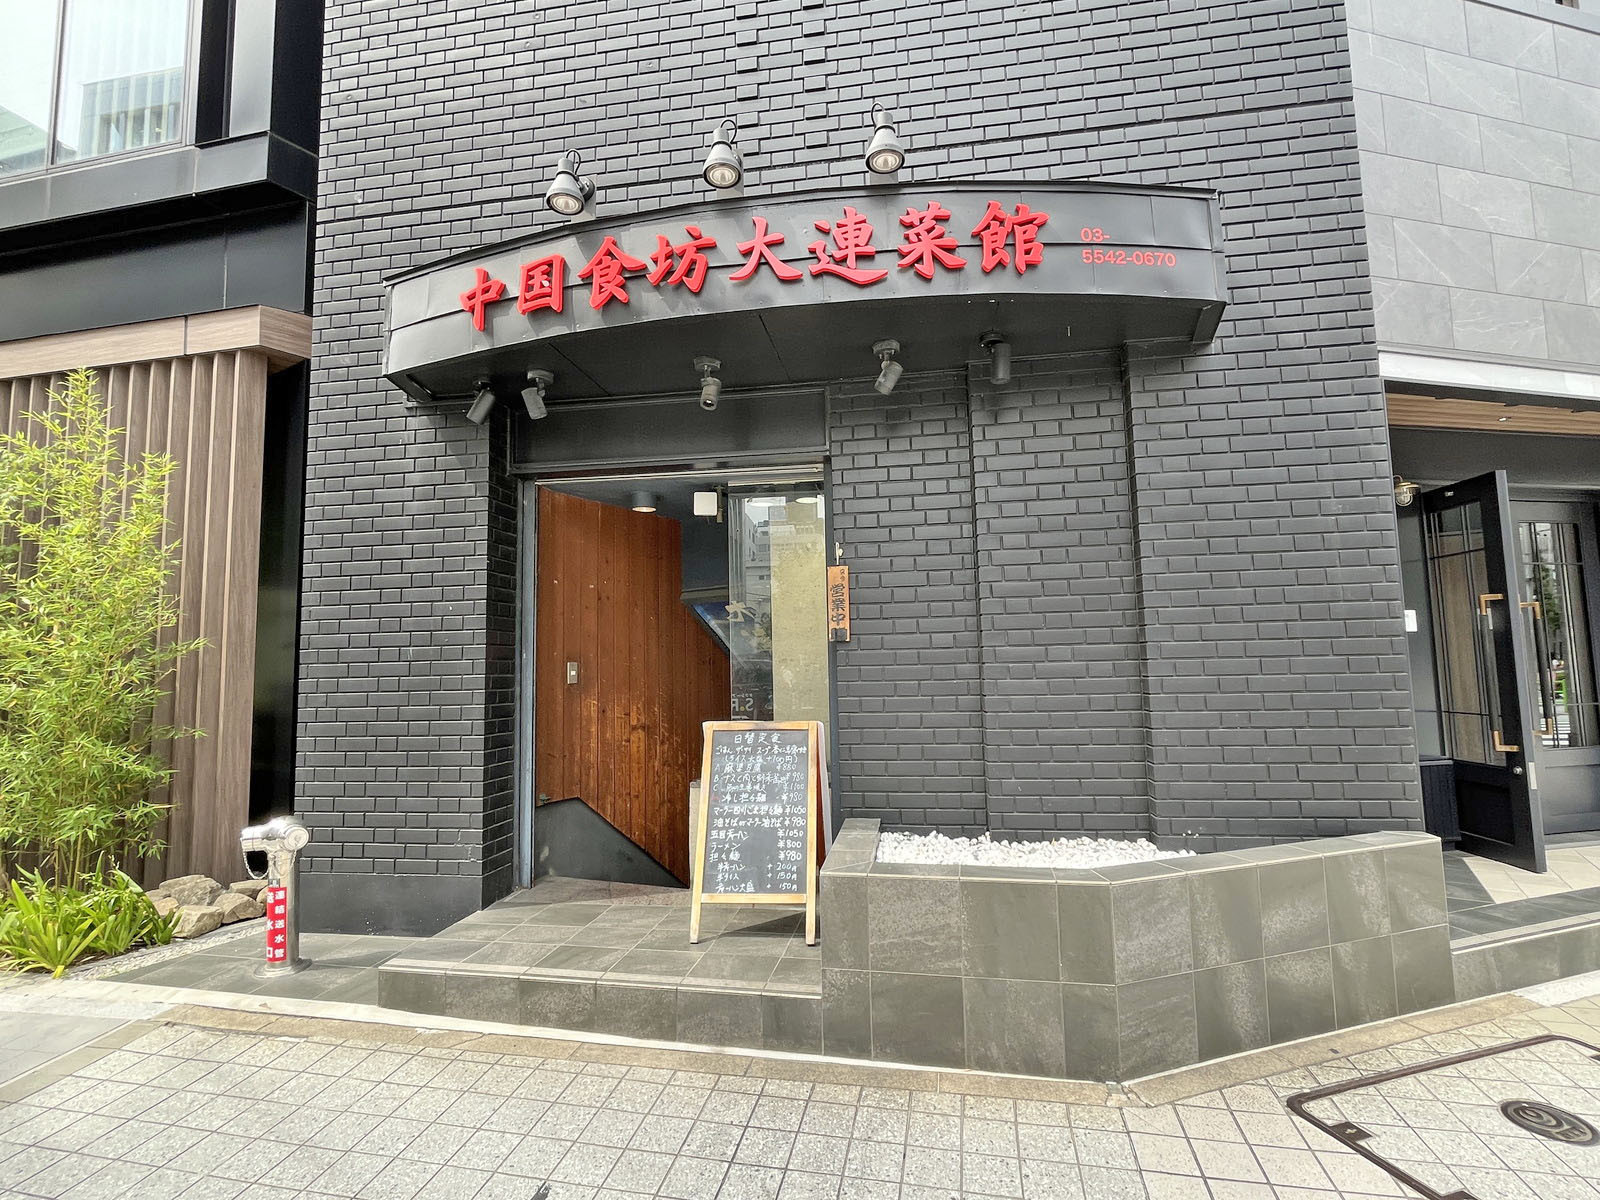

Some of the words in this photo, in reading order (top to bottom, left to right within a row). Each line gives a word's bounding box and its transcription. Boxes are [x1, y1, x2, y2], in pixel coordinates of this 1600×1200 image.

[1080, 227, 1111, 243] 03-
[1081, 249, 1177, 267] 5542-0670
[459, 201, 1049, 332] 中国食坊大連菜館
[831, 582, 846, 626] 営業中
[777, 828, 804, 838] ¥1050
[711, 842, 741, 853] ラーメン
[777, 840, 802, 848] ¥800
[778, 850, 802, 861] ¥980
